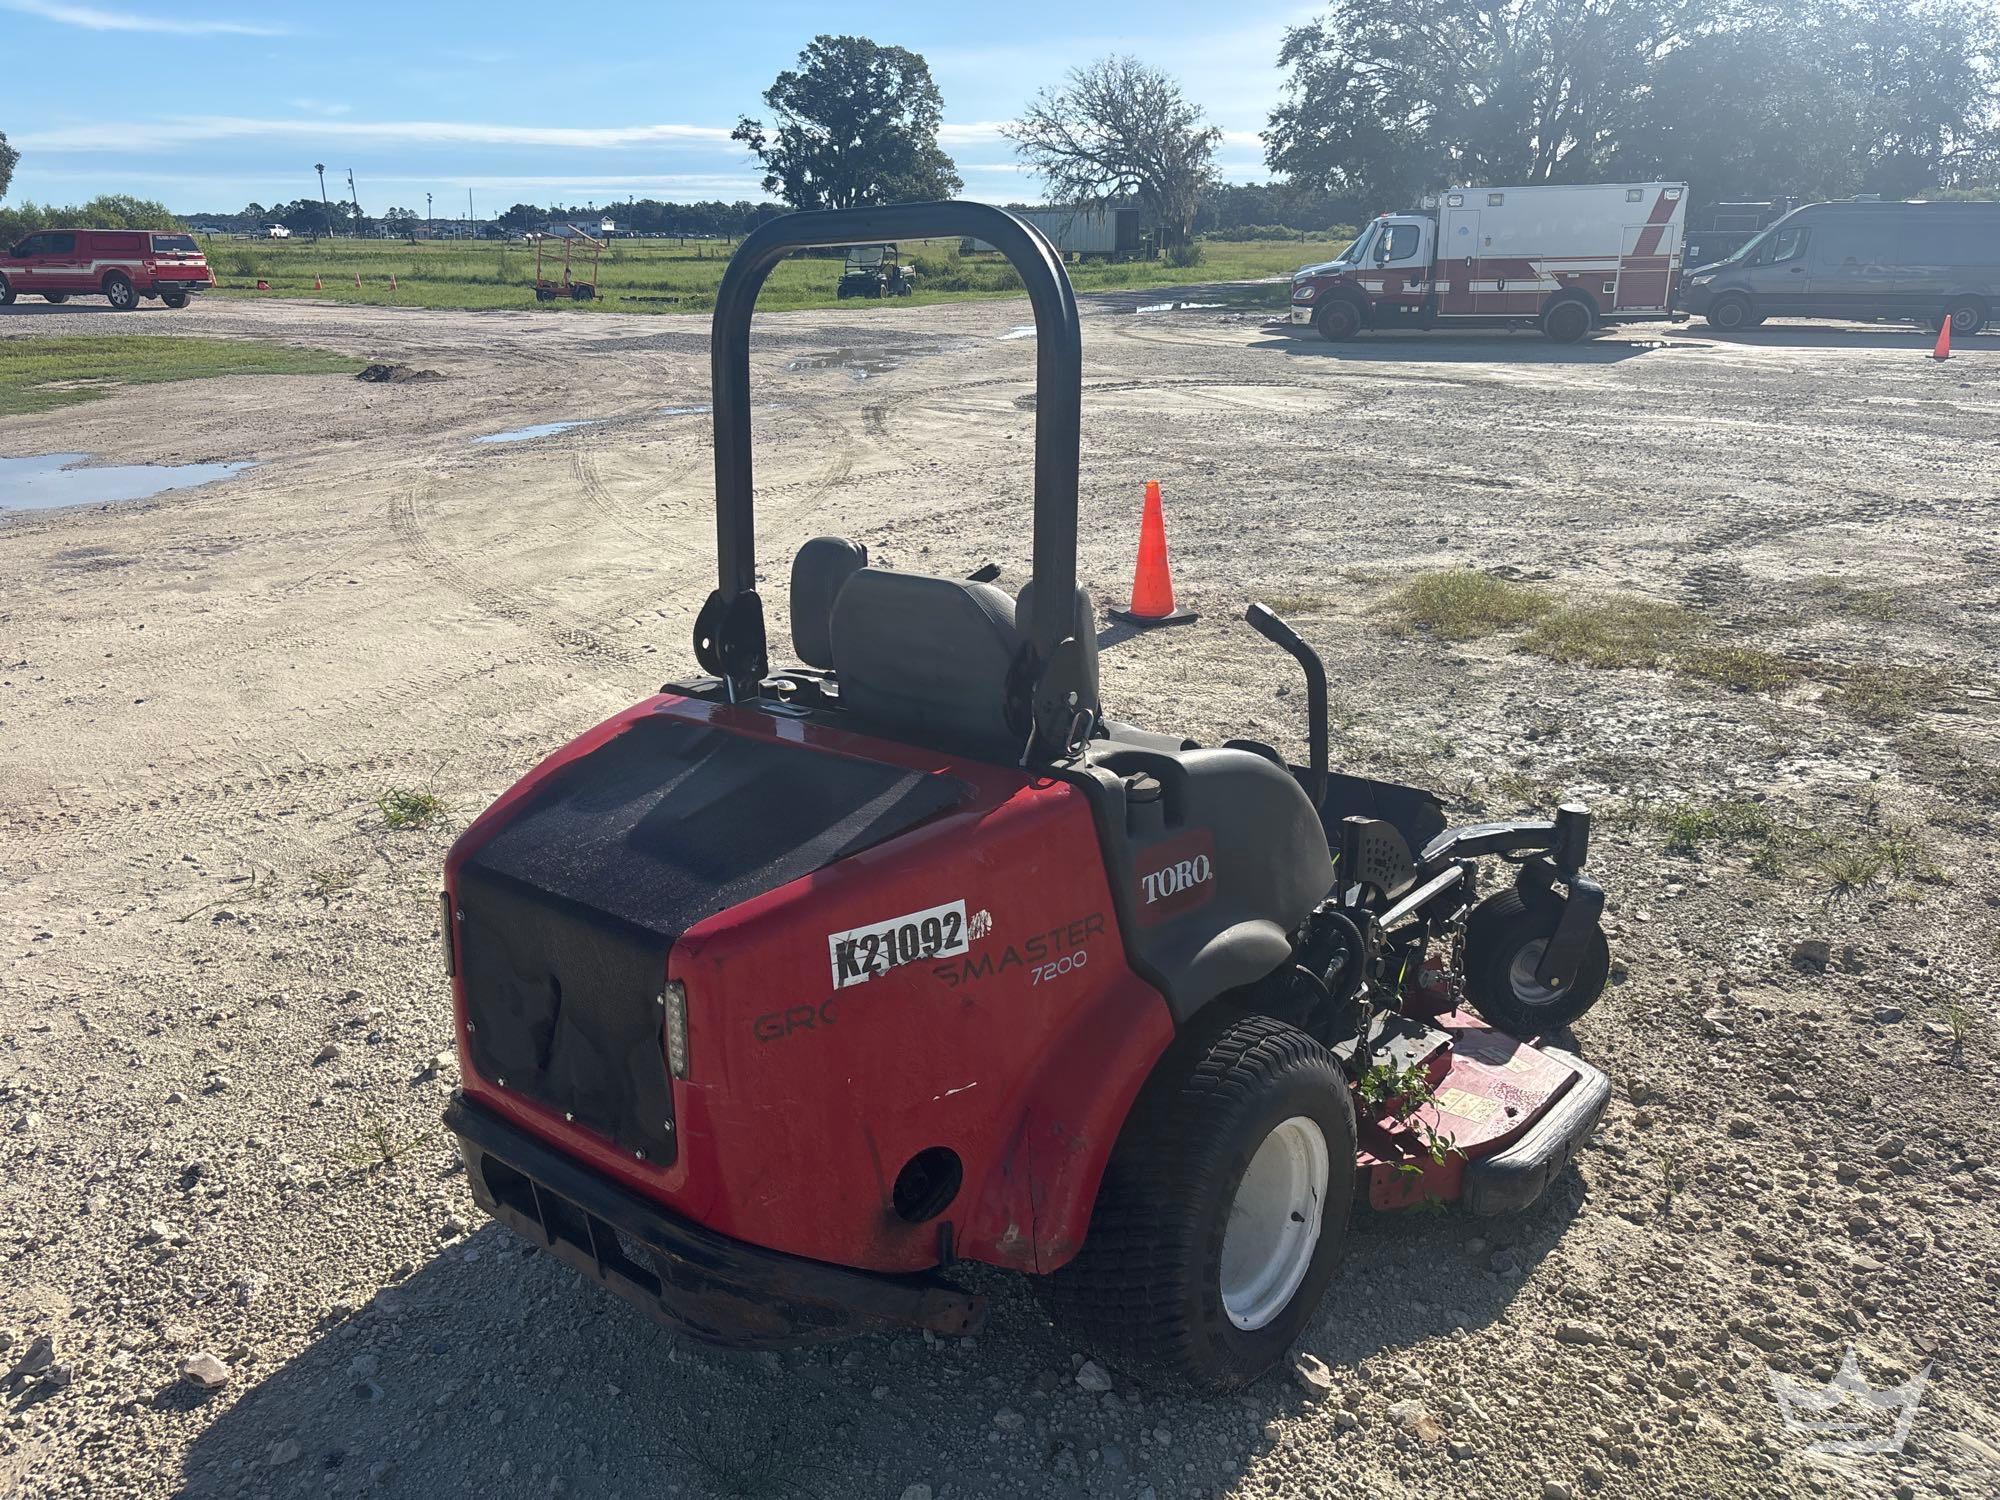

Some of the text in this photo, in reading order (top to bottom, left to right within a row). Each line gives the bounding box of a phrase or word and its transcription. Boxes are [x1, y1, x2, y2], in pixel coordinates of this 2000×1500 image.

[1142, 854, 1209, 904] TORO
[835, 911, 964, 981] K21092
[1031, 950, 1087, 986] 7200
